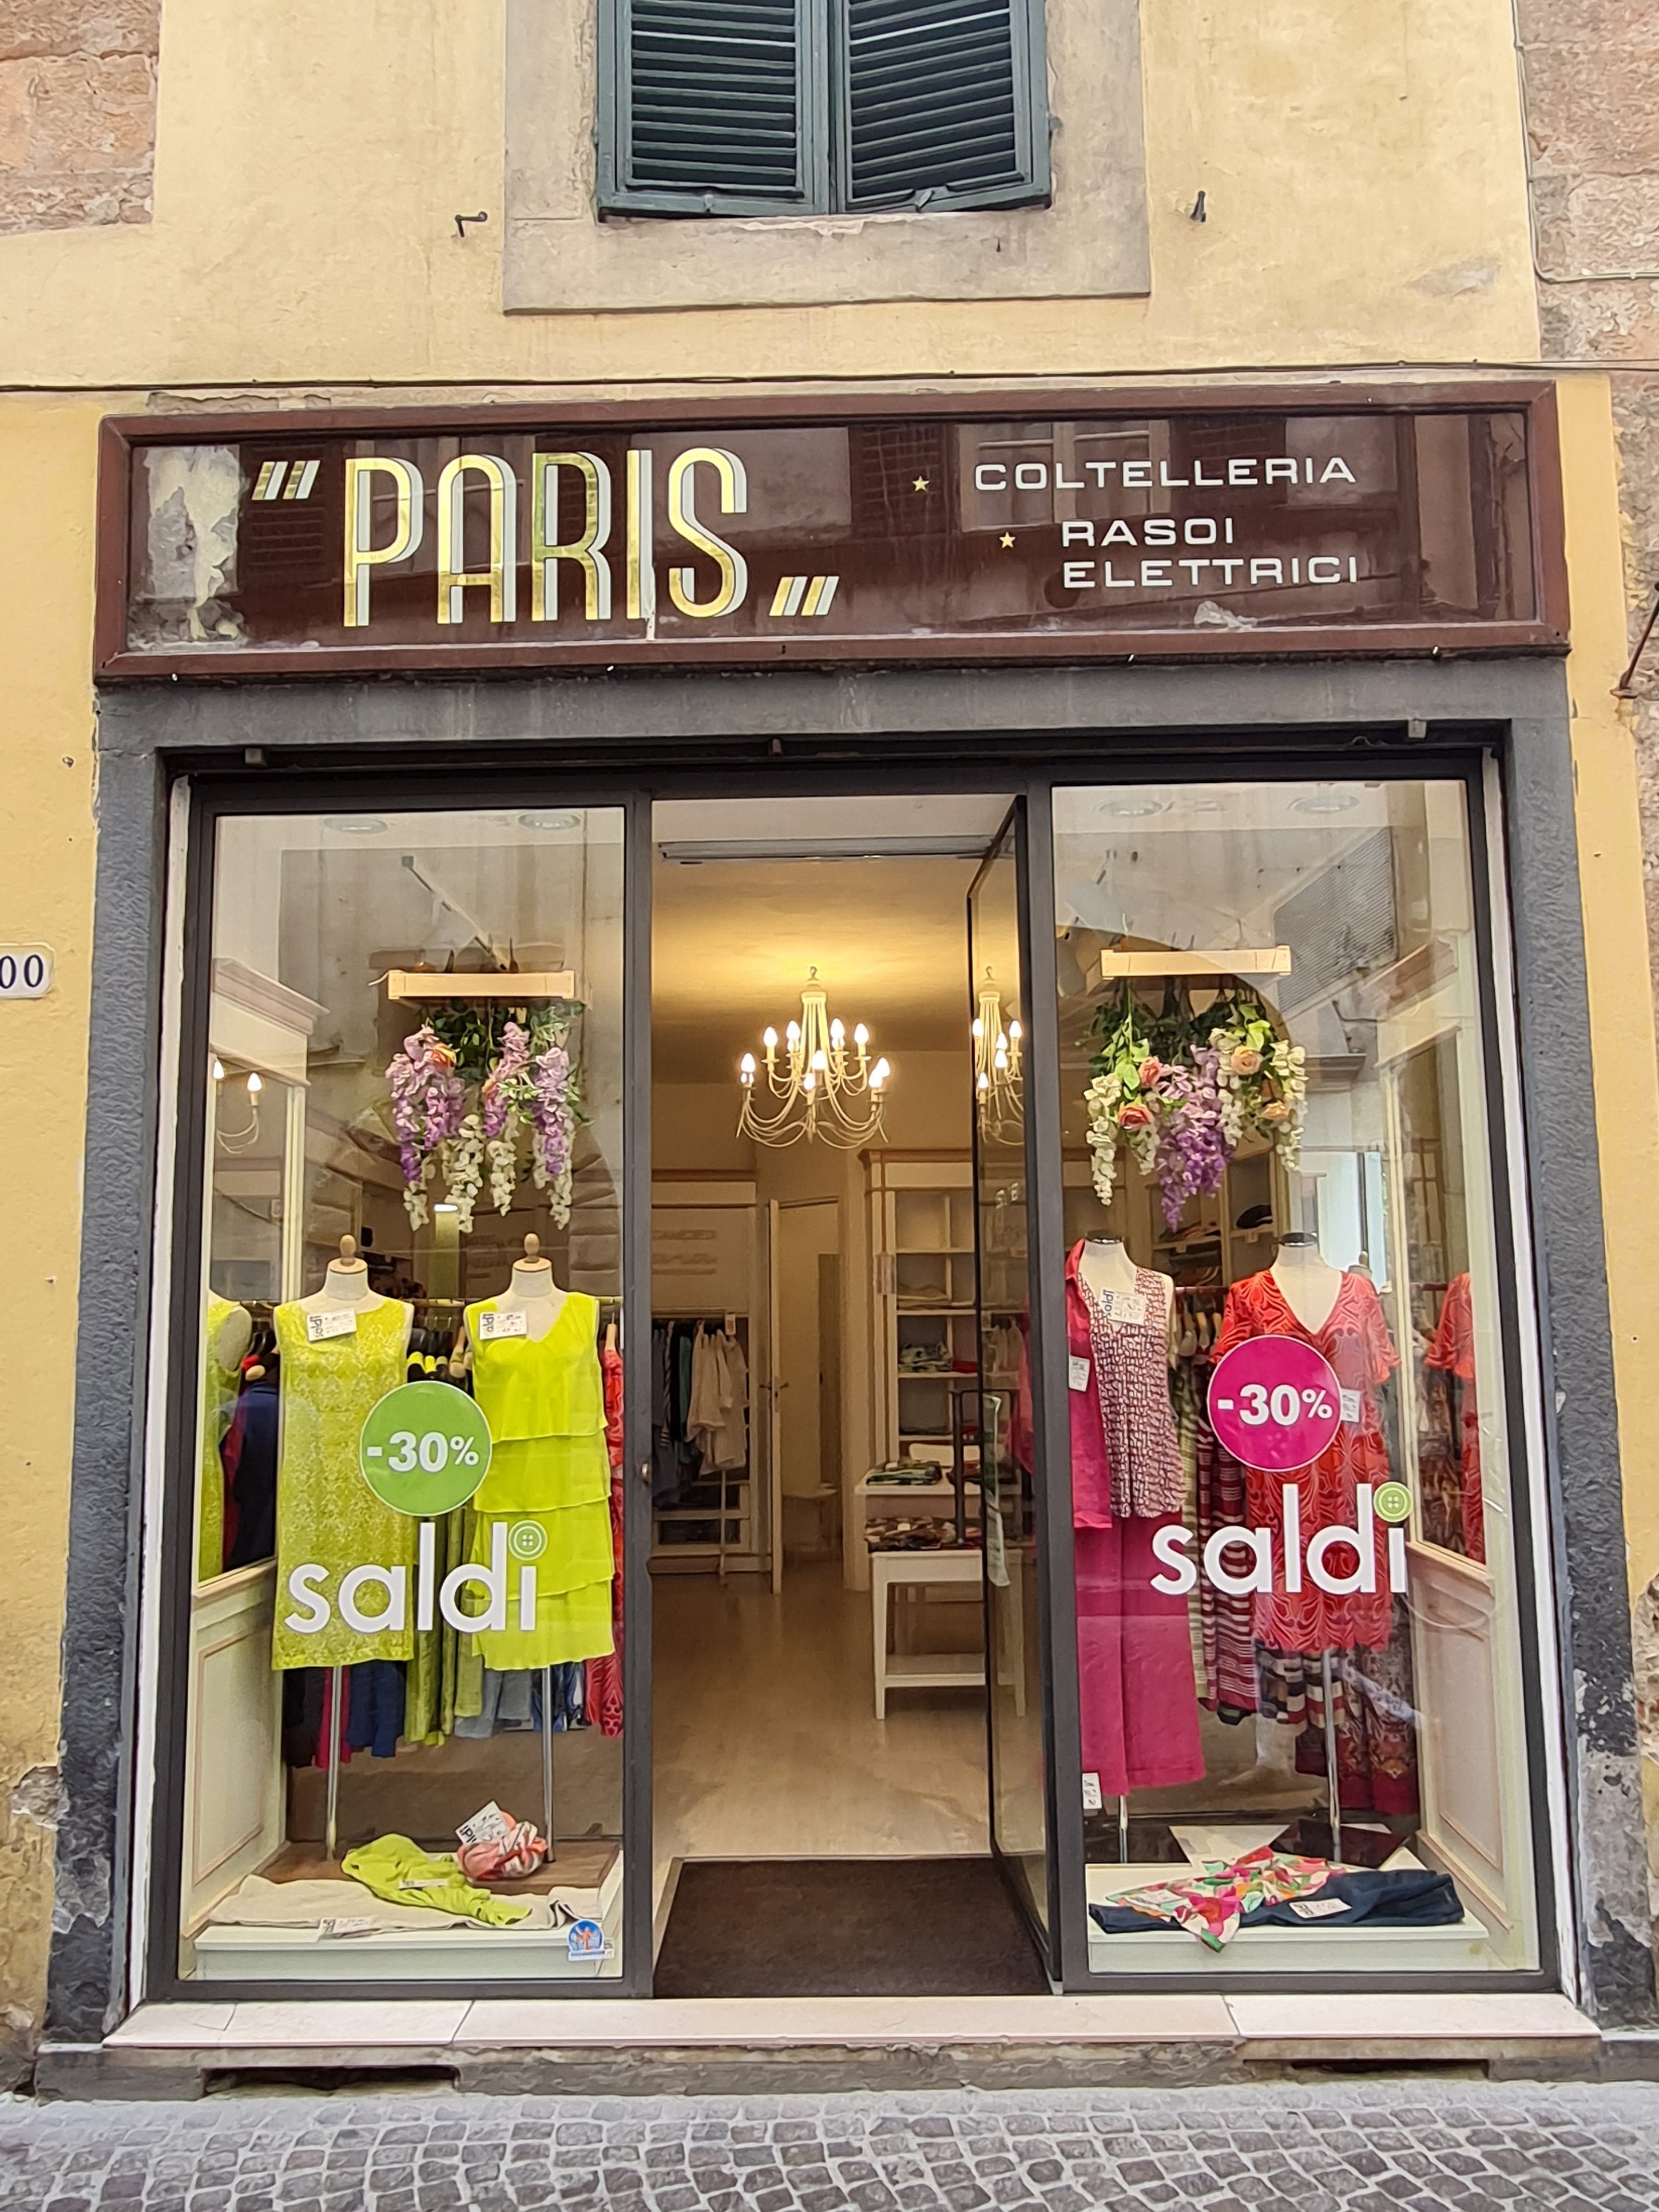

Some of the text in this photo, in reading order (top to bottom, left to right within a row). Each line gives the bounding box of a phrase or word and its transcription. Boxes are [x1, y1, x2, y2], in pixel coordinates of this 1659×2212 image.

[974, 457, 1356, 491] COLTELLERIA
[344, 447, 748, 627] PARIS
[1062, 517, 1233, 547] RASOI
[1063, 556, 1358, 589] ELETTRICI
[1217, 1384, 1333, 1426] -30%
[367, 1431, 479, 1473] -30%
[1150, 1481, 1413, 1595] saldi
[284, 1520, 548, 1634] saldi
